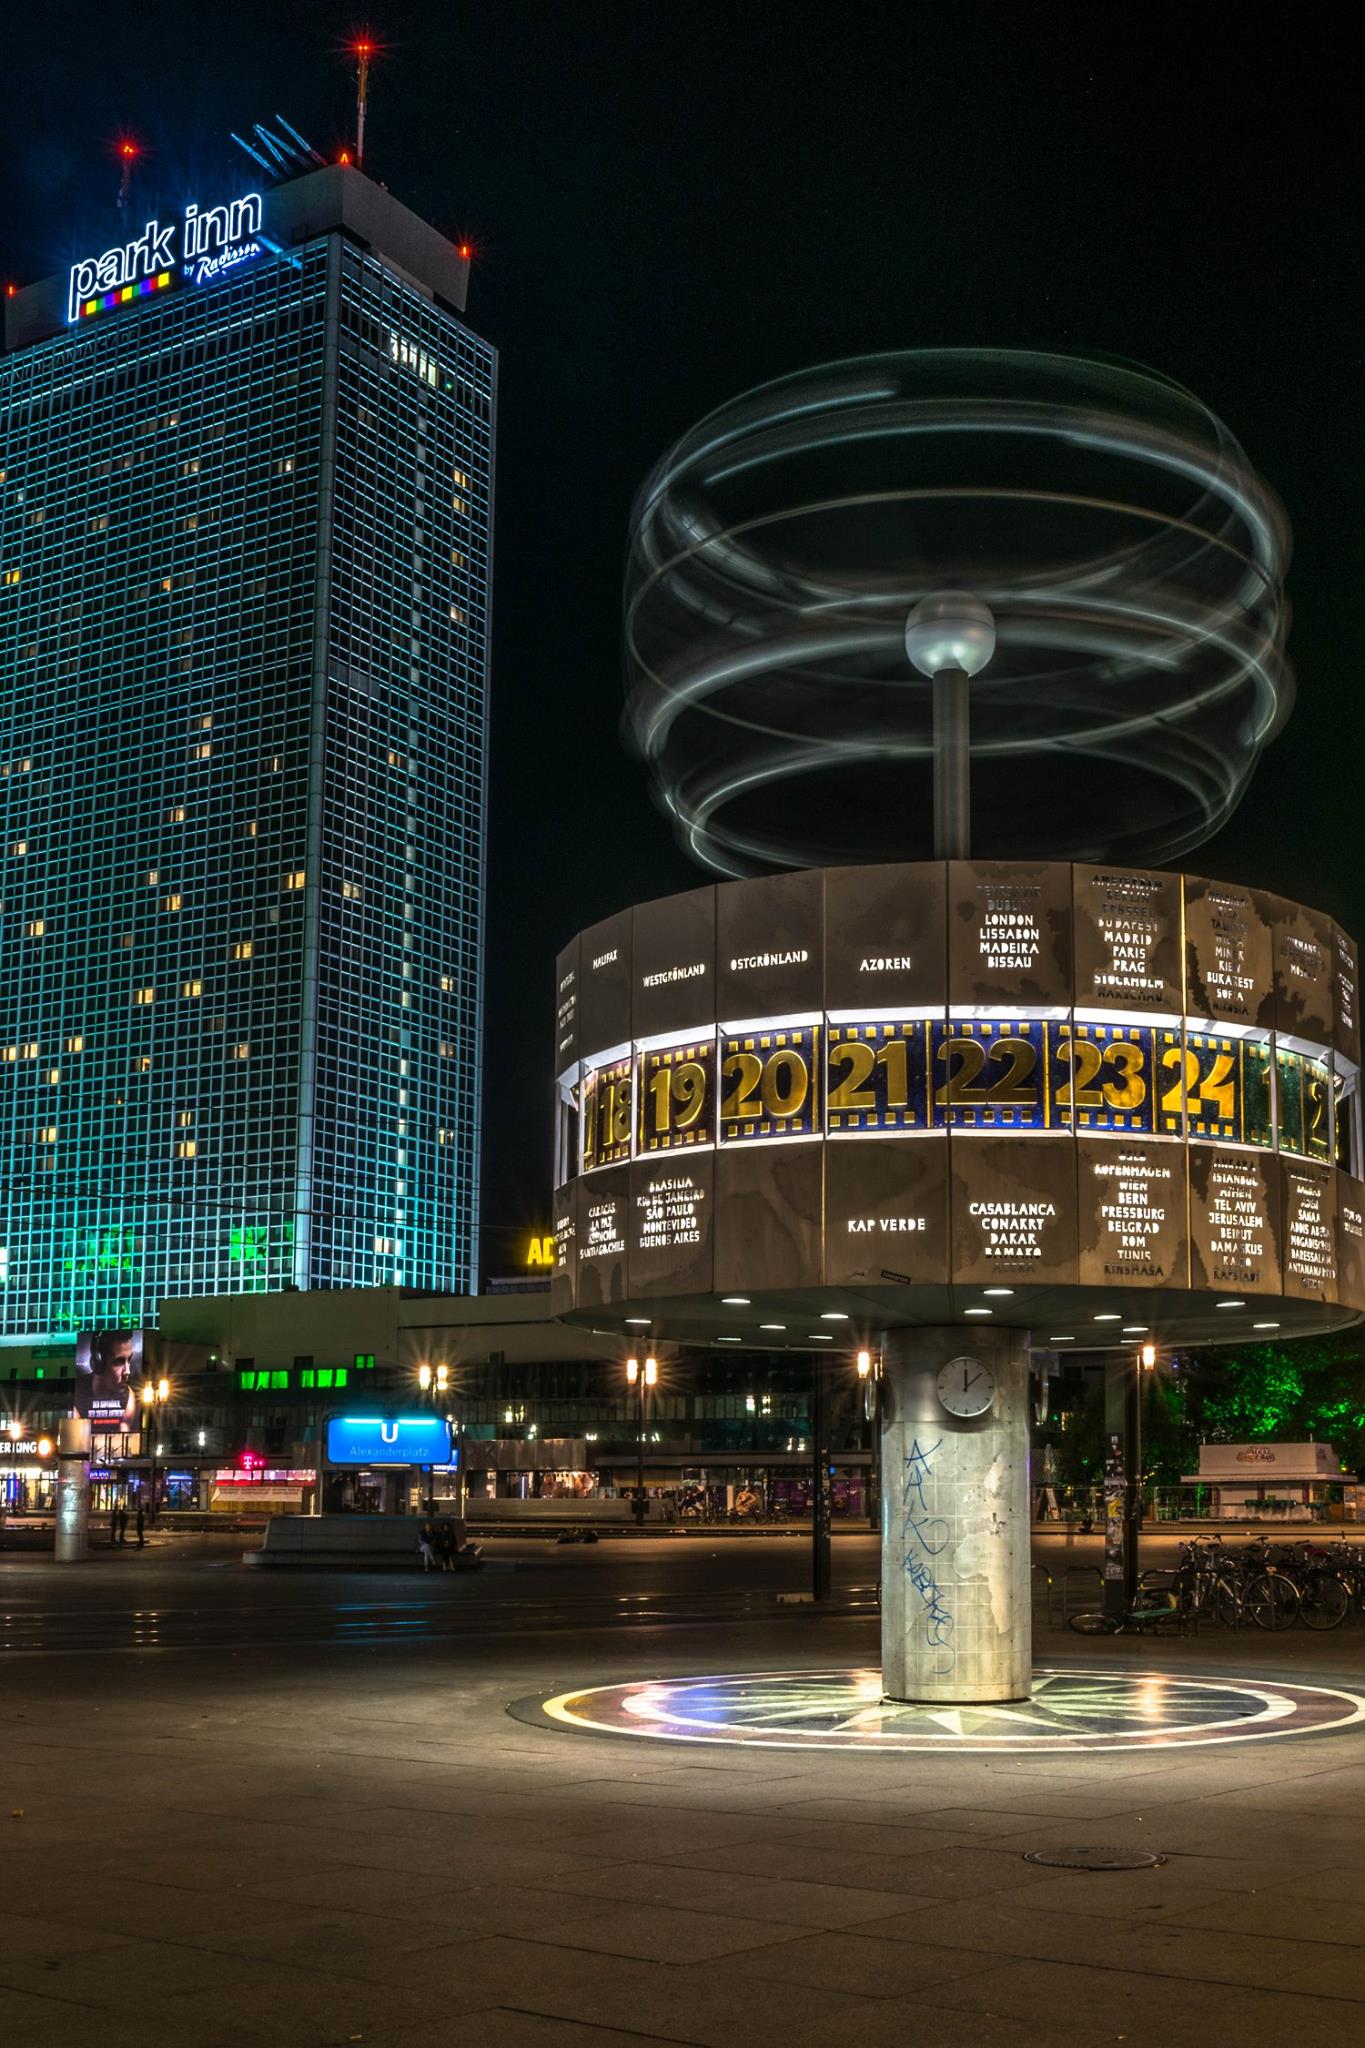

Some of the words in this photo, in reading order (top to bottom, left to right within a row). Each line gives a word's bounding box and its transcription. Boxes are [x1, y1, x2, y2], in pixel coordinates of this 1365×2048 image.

[68, 220, 176, 323] park
[184, 193, 262, 259] inn
[184, 264, 195, 276] by
[197, 243, 261, 284] Radisson
[987, 900, 1032, 911] DUBL
[985, 914, 1034, 926] LONDON
[979, 928, 1040, 940] LISSABON
[1104, 931, 1152, 945] MADRID
[979, 942, 1040, 954] MADEIRA
[1112, 946, 1146, 959] PARIS
[1215, 946, 1245, 961] MINK
[593, 949, 618, 970] HALIFAX
[730, 950, 808, 970] OSTGRÖNLAND
[859, 957, 911, 971] AZOREN
[987, 956, 1033, 968] BISSAU
[1113, 959, 1146, 973] PRAG
[643, 964, 705, 988] WESTGRÖNLAND
[1094, 974, 1164, 989] STOCKHOLM
[827, 1041, 909, 1110] 21
[936, 1038, 1038, 1106] 22
[1055, 1040, 1148, 1110] 23
[720, 1049, 808, 1119] 20
[1161, 1048, 1235, 1119] 24
[650, 1062, 706, 1132] 19
[598, 1078, 630, 1147] 18
[1094, 1164, 1171, 1178] KOPENHAGEN
[650, 1176, 694, 1193] BRASILIA
[1119, 1180, 1148, 1191] WIEN
[1212, 1173, 1259, 1187] ISTANBUL
[1118, 1192, 1148, 1205] BERN
[1214, 1198, 1231, 1211] TEL
[1235, 1201, 1256, 1213] AVIV
[588, 1202, 616, 1218] CARACAS
[646, 1206, 663, 1220] SÃO
[666, 1203, 694, 1217] PAULO
[969, 1202, 1056, 1216] CASABLANCA
[1101, 1205, 1165, 1220] PRESSBURG
[643, 1216, 697, 1234] MONTEVIDEO
[848, 1220, 875, 1232] KAP
[880, 1218, 926, 1231] VERDE
[981, 1217, 1045, 1230] CONAKRY
[1107, 1220, 1160, 1234] BELGRAD
[1208, 1212, 1263, 1228] JERUSALEM
[1290, 1221, 1309, 1235] ADDIS
[639, 1234, 671, 1248] BUENOS
[673, 1230, 700, 1244] AIRES
[990, 1232, 1037, 1245] DAKAR
[1121, 1235, 1146, 1247] ROM
[1117, 1249, 1151, 1261] TUNIS
[381, 1422, 399, 1444] U
[350, 1445, 429, 1458] Alexanderplatz
